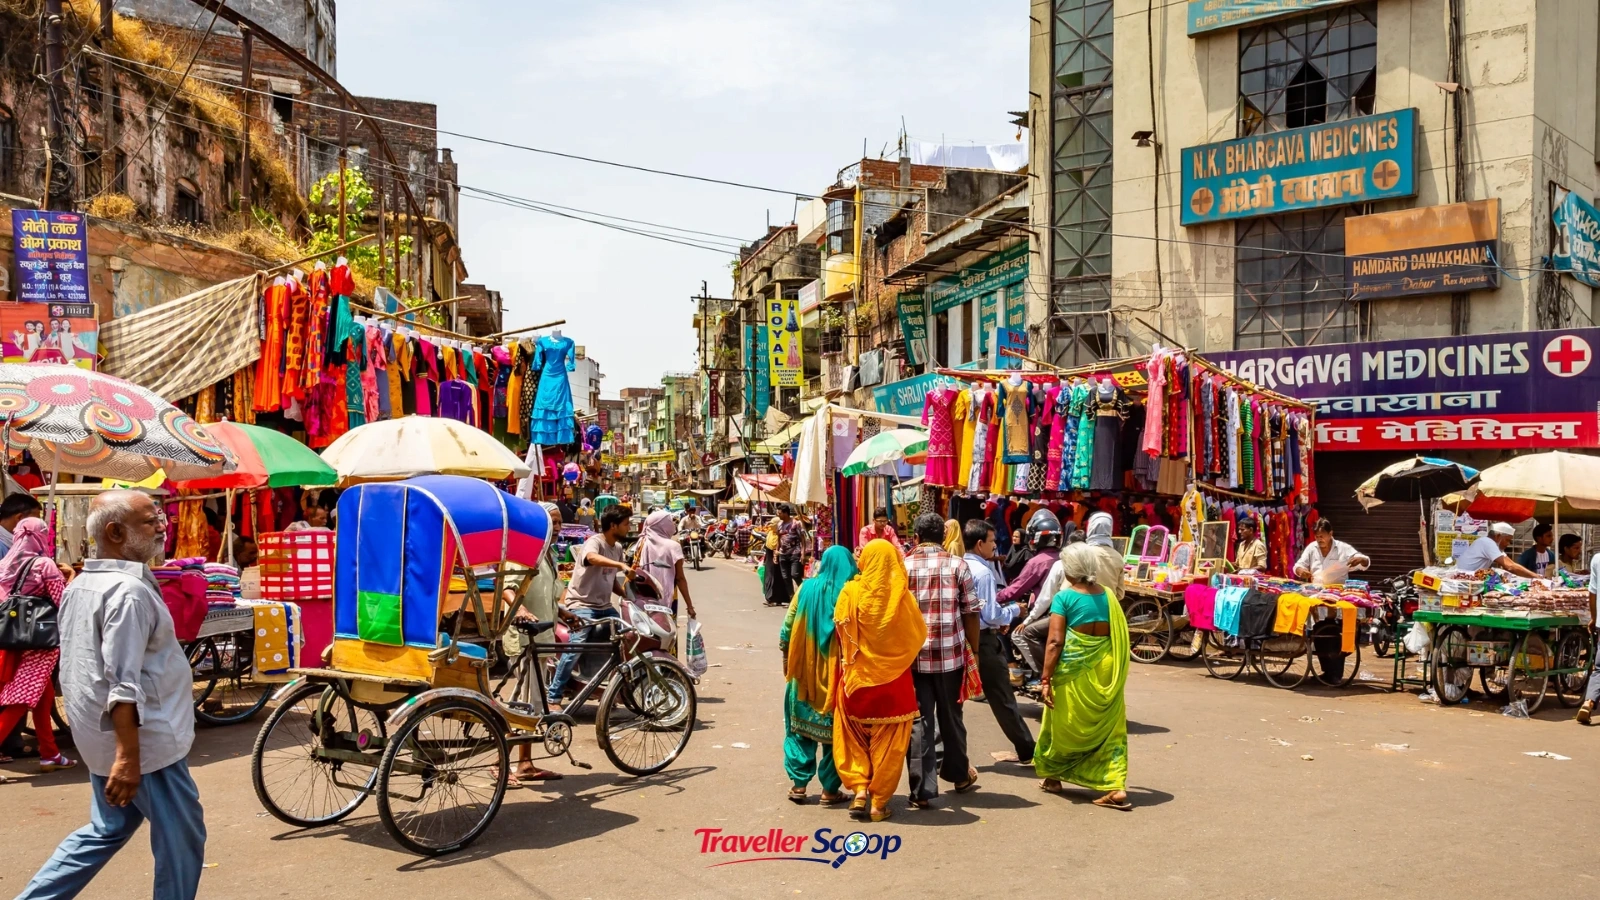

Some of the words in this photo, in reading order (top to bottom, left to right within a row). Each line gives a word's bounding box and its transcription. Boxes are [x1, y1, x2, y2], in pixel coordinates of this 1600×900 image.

[1194, 149, 1221, 179] N.K.
[1226, 134, 1305, 175] BHARGAVA
[1310, 117, 1398, 161] MEDICINES
[1219, 174, 1276, 214] अंग्रेजी
[1281, 167, 1366, 204] दवाखाना
[22, 218, 48, 233] मोती
[51, 223, 77, 234] लाल
[20, 234, 44, 249] ओम
[47, 238, 82, 251] प्रकाश
[1353, 255, 1407, 276] HAMDARD
[1411, 247, 1488, 271] DAWAKHANA
[1401, 277, 1436, 291] Dabur
[1443, 274, 1458, 286] Rex
[67, 306, 90, 314] mart
[771, 303, 784, 368] ROYAL
[1008, 332, 1027, 345] TAJ
[1210, 353, 1351, 389] HARGAVA
[1362, 342, 1530, 381] MEDICINES
[1376, 418, 1582, 442] मेडिसिन्स
